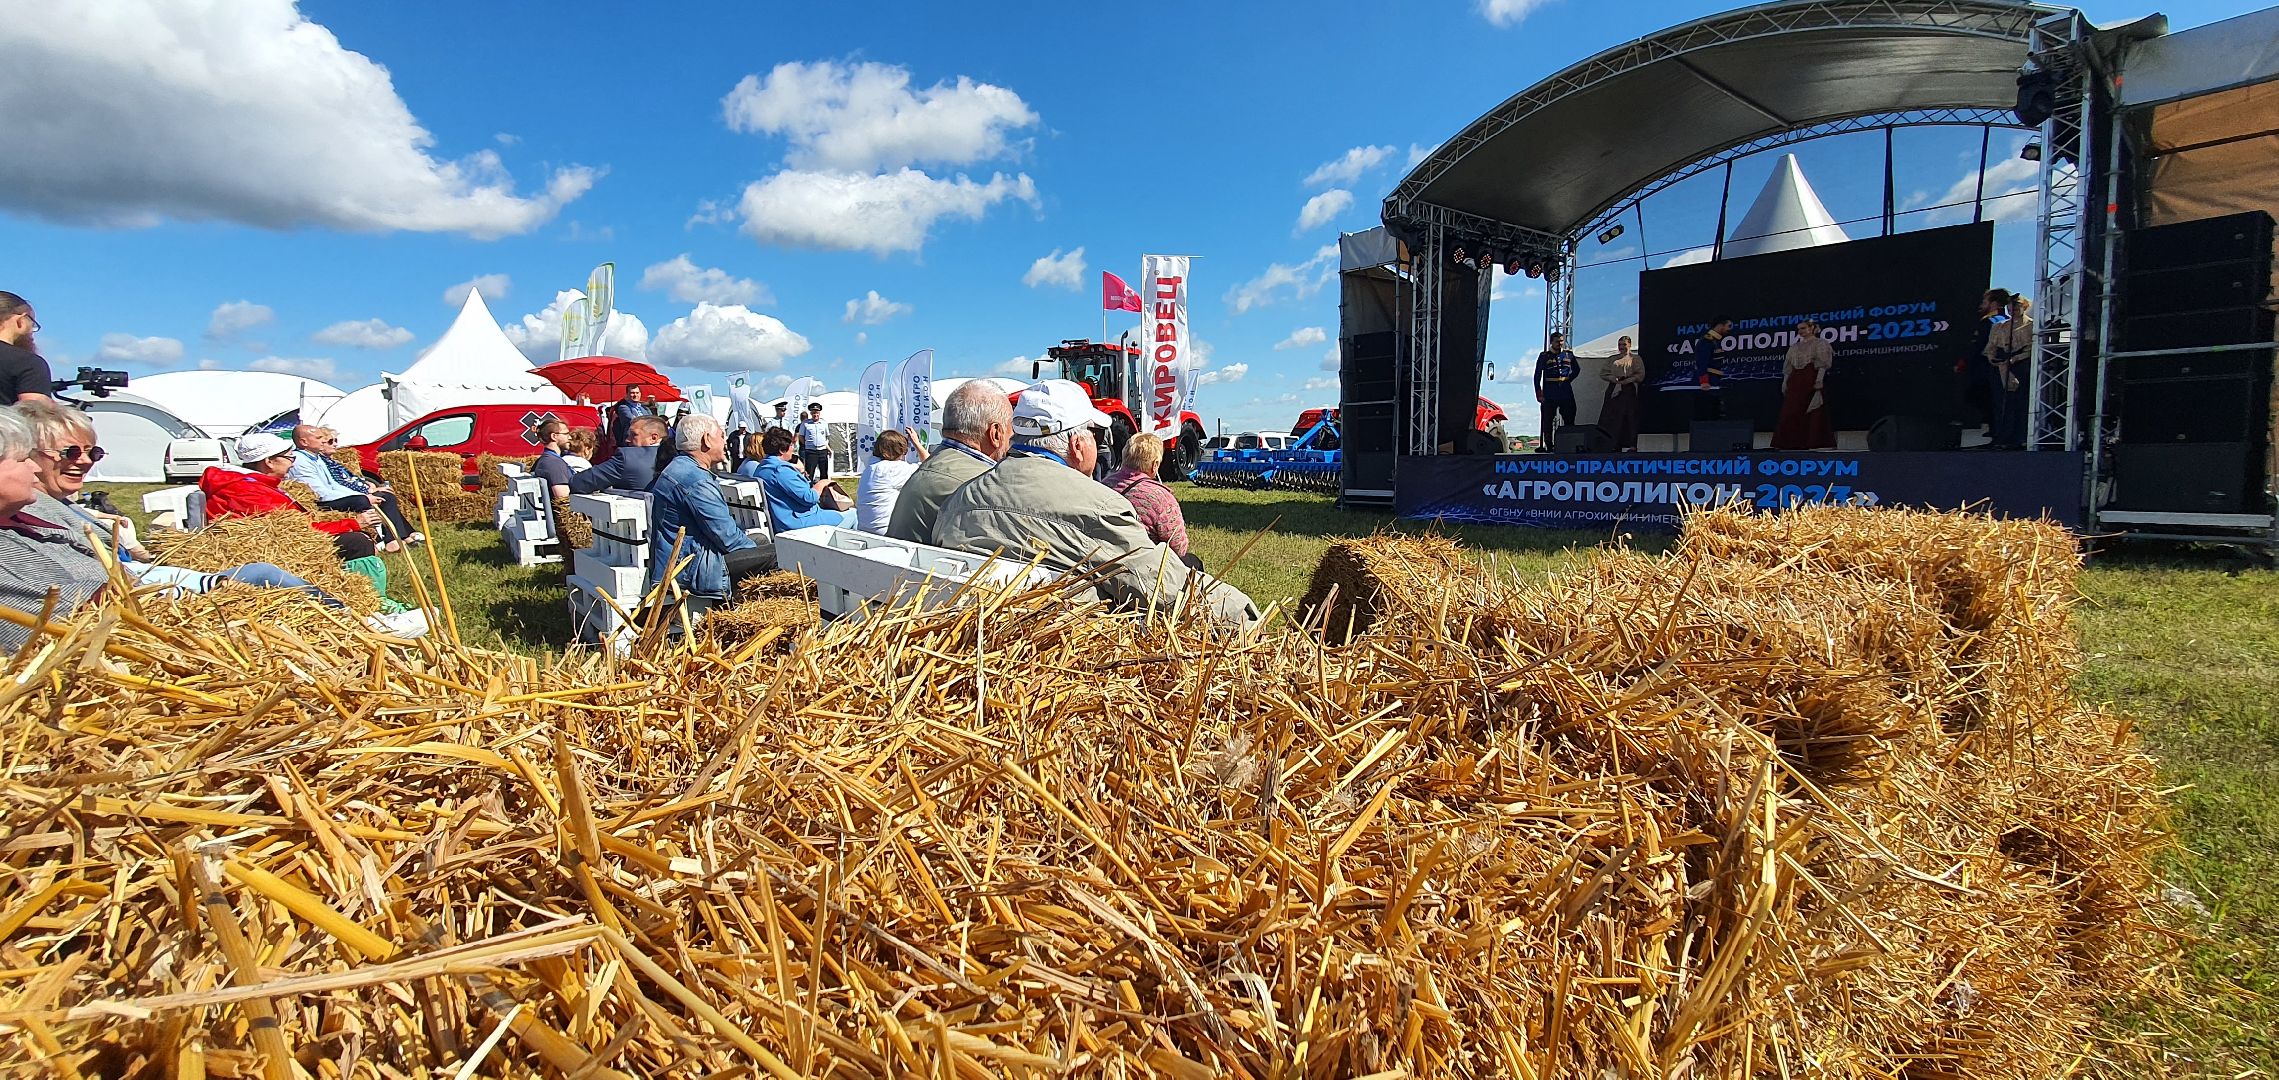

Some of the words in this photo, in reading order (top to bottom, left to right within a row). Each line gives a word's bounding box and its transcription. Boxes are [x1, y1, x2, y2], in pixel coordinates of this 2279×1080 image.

[1869, 301, 1936, 317] ФОРУМ
[1667, 319, 1950, 355] «АОПОЛИОН-2023»
[1153, 276, 1182, 431] КИРОВЕЦ
[912, 375, 921, 424] ФОСАГРО
[922, 376, 930, 425] РЕГИОН
[1495, 456, 1750, 475] НАУЧНО-ПРАКТИЧЕСКИЙ
[1758, 459, 1859, 476] ФОРУМ
[1482, 480, 1880, 508] «АГРОПОЛИГОН-2023»
[1489, 507, 1524, 518] ФГБНУ
[1525, 509, 1562, 519] «ВНИИ
[1564, 510, 1639, 521] АГРОХИМИИ
